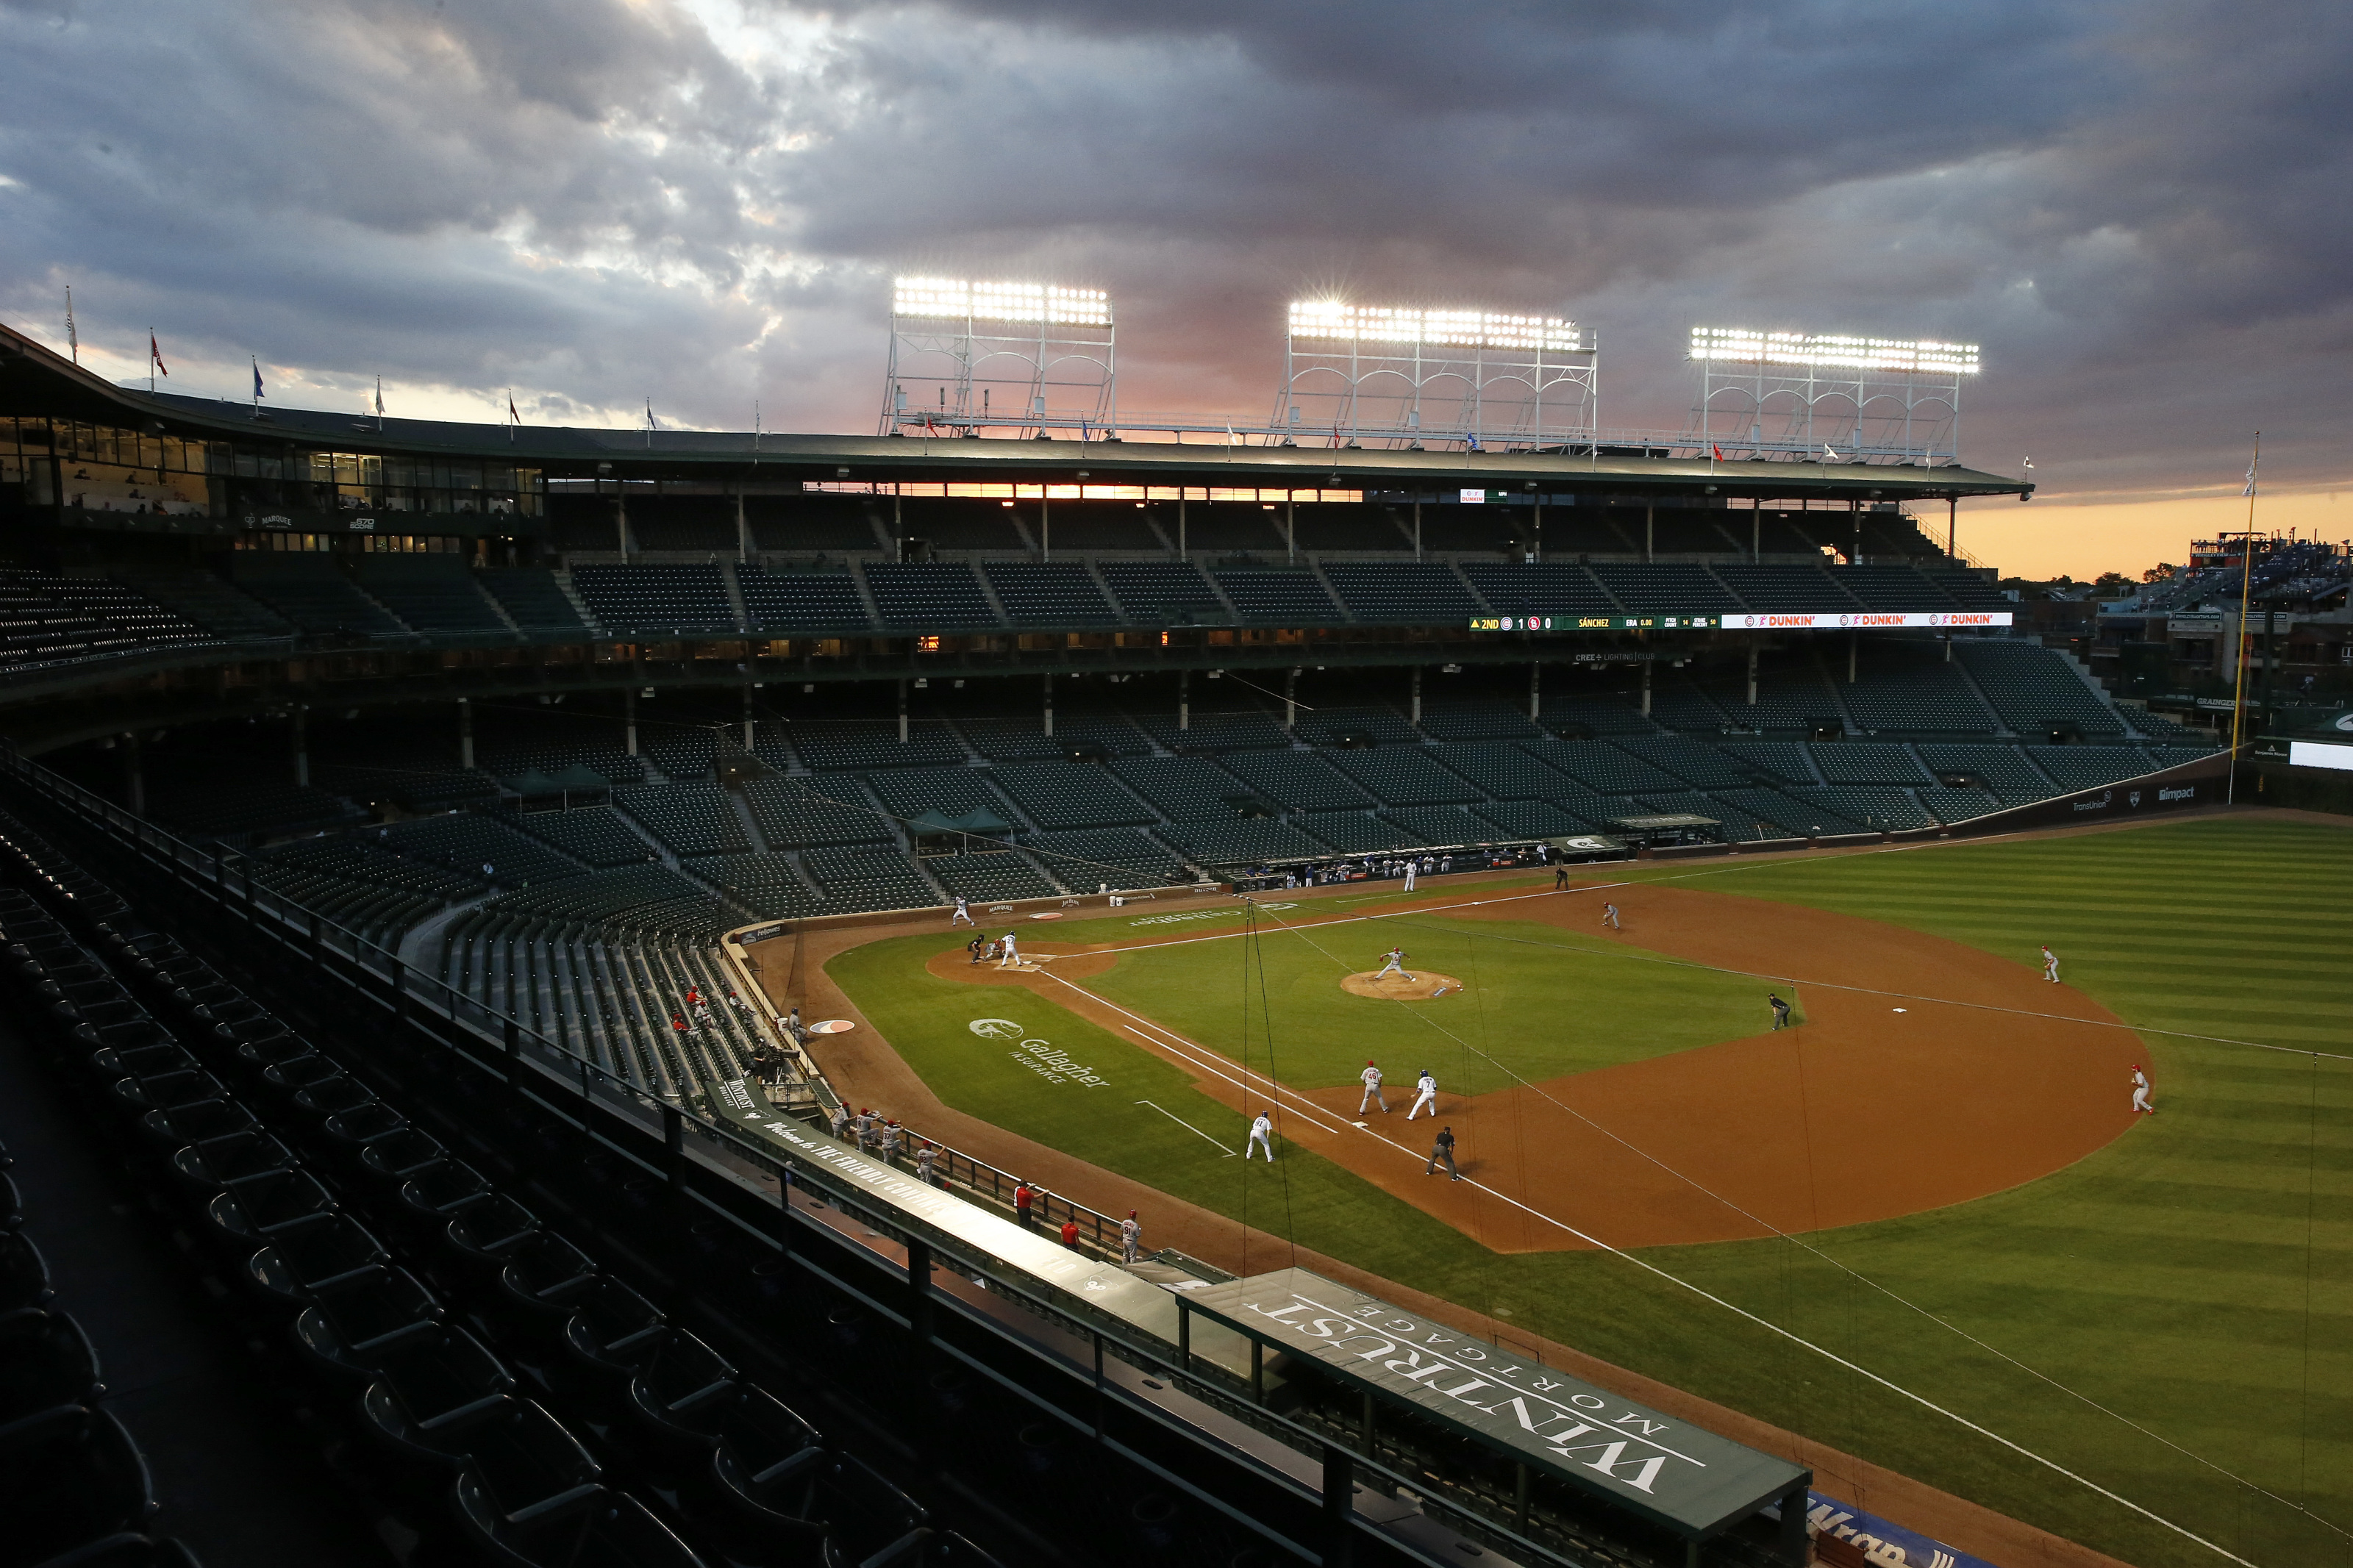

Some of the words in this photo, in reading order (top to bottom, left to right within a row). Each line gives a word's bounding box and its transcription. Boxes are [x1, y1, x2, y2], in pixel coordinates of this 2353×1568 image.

[262, 515, 292, 526] MARQUEE
[1481, 619, 1499, 629] 2ND
[1518, 618, 1524, 629] 1
[1545, 618, 1551, 629] 0
[1578, 617, 1609, 628] SÁNCHEZ
[1769, 616, 1815, 626] DUNKIN'
[1863, 615, 1906, 625] DUNKIN'
[1951, 615, 1993, 624] DUNKIN'
[2196, 698, 2236, 706] GRAINGER
[2165, 787, 2194, 801] impact
[2073, 800, 2106, 811] TransUnion
[989, 904, 1013, 913] MARQUEE
[757, 926, 781, 937] Fellowes
[1008, 1051, 1067, 1084] INSURANCE
[1020, 1039, 1110, 1088] Gallagher
[728, 1078, 755, 1109] WINTRUST
[763, 1122, 804, 1143] Welcome
[810, 1145, 843, 1160] THE
[831, 1156, 896, 1186] FRIENDLY
[1124, 1226, 1131, 1235] 91
[1353, 1305, 1670, 1436] MORTGAGE
[1247, 1300, 1669, 1495] WINTRUST
